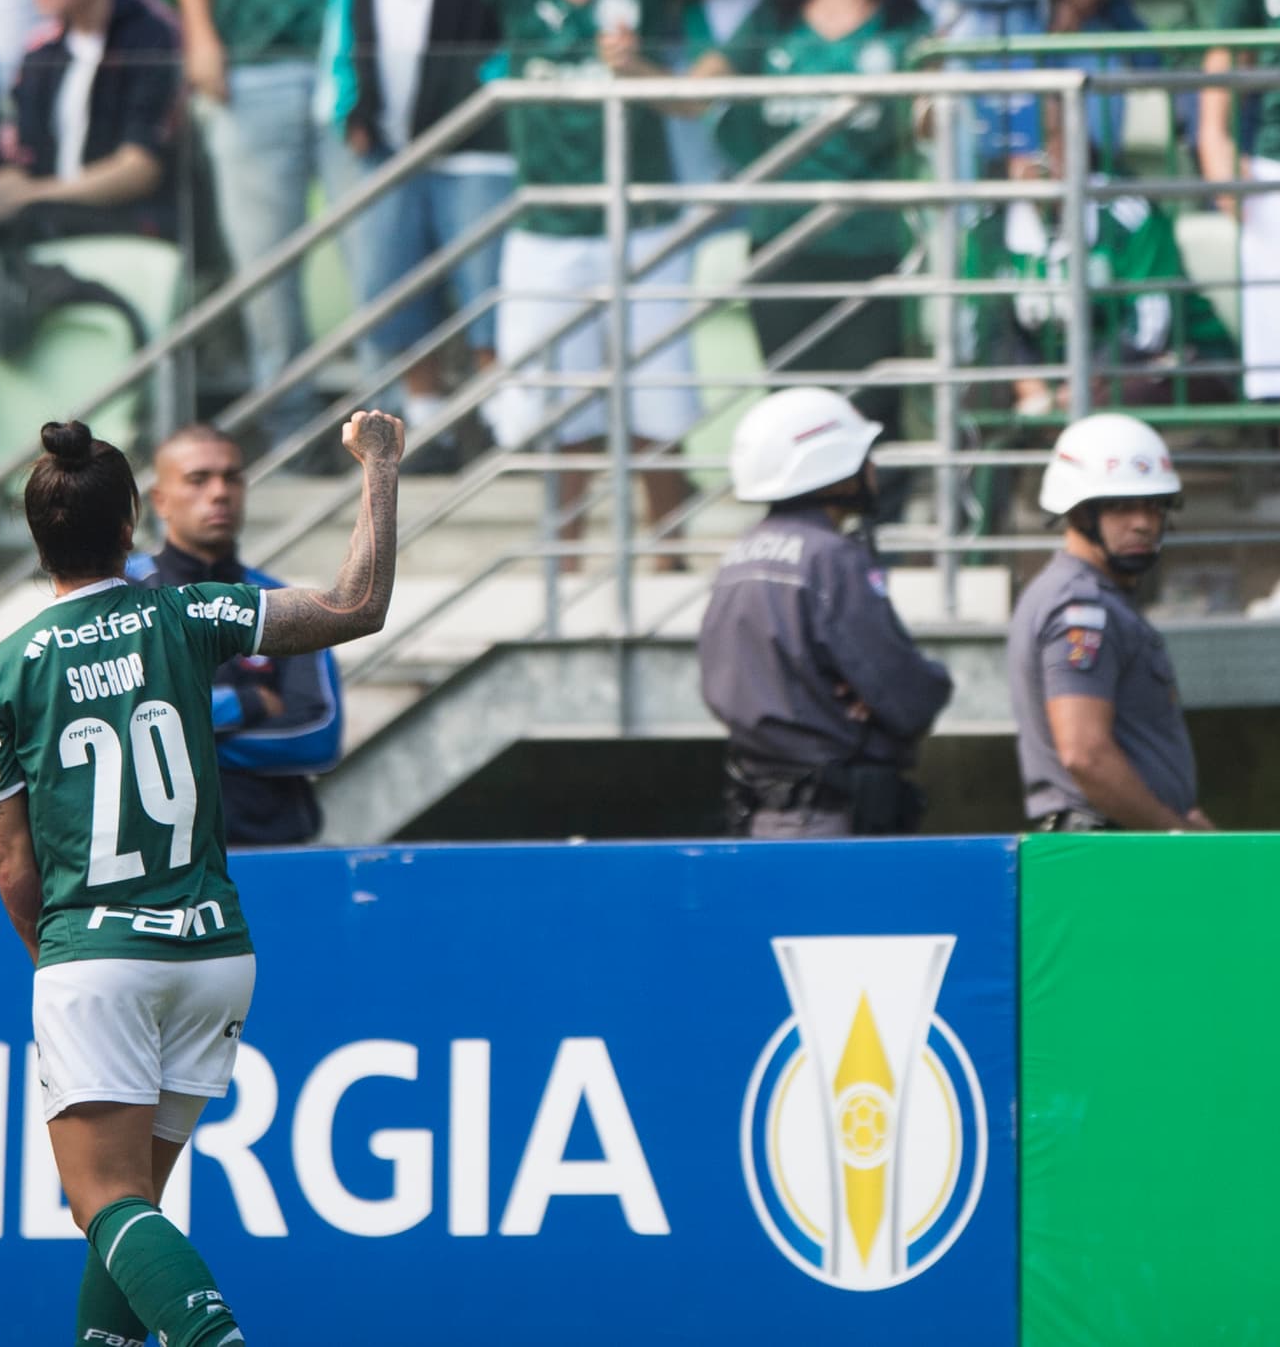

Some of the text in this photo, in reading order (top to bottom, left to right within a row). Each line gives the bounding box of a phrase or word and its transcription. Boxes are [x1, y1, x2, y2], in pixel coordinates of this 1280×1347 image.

[52, 604, 157, 650] betfair
[186, 595, 256, 627] crefisa
[66, 652, 146, 704] SOCHOR
[68, 725, 103, 740] crefisa
[135, 707, 168, 723] crefisa
[58, 700, 197, 887] 29
